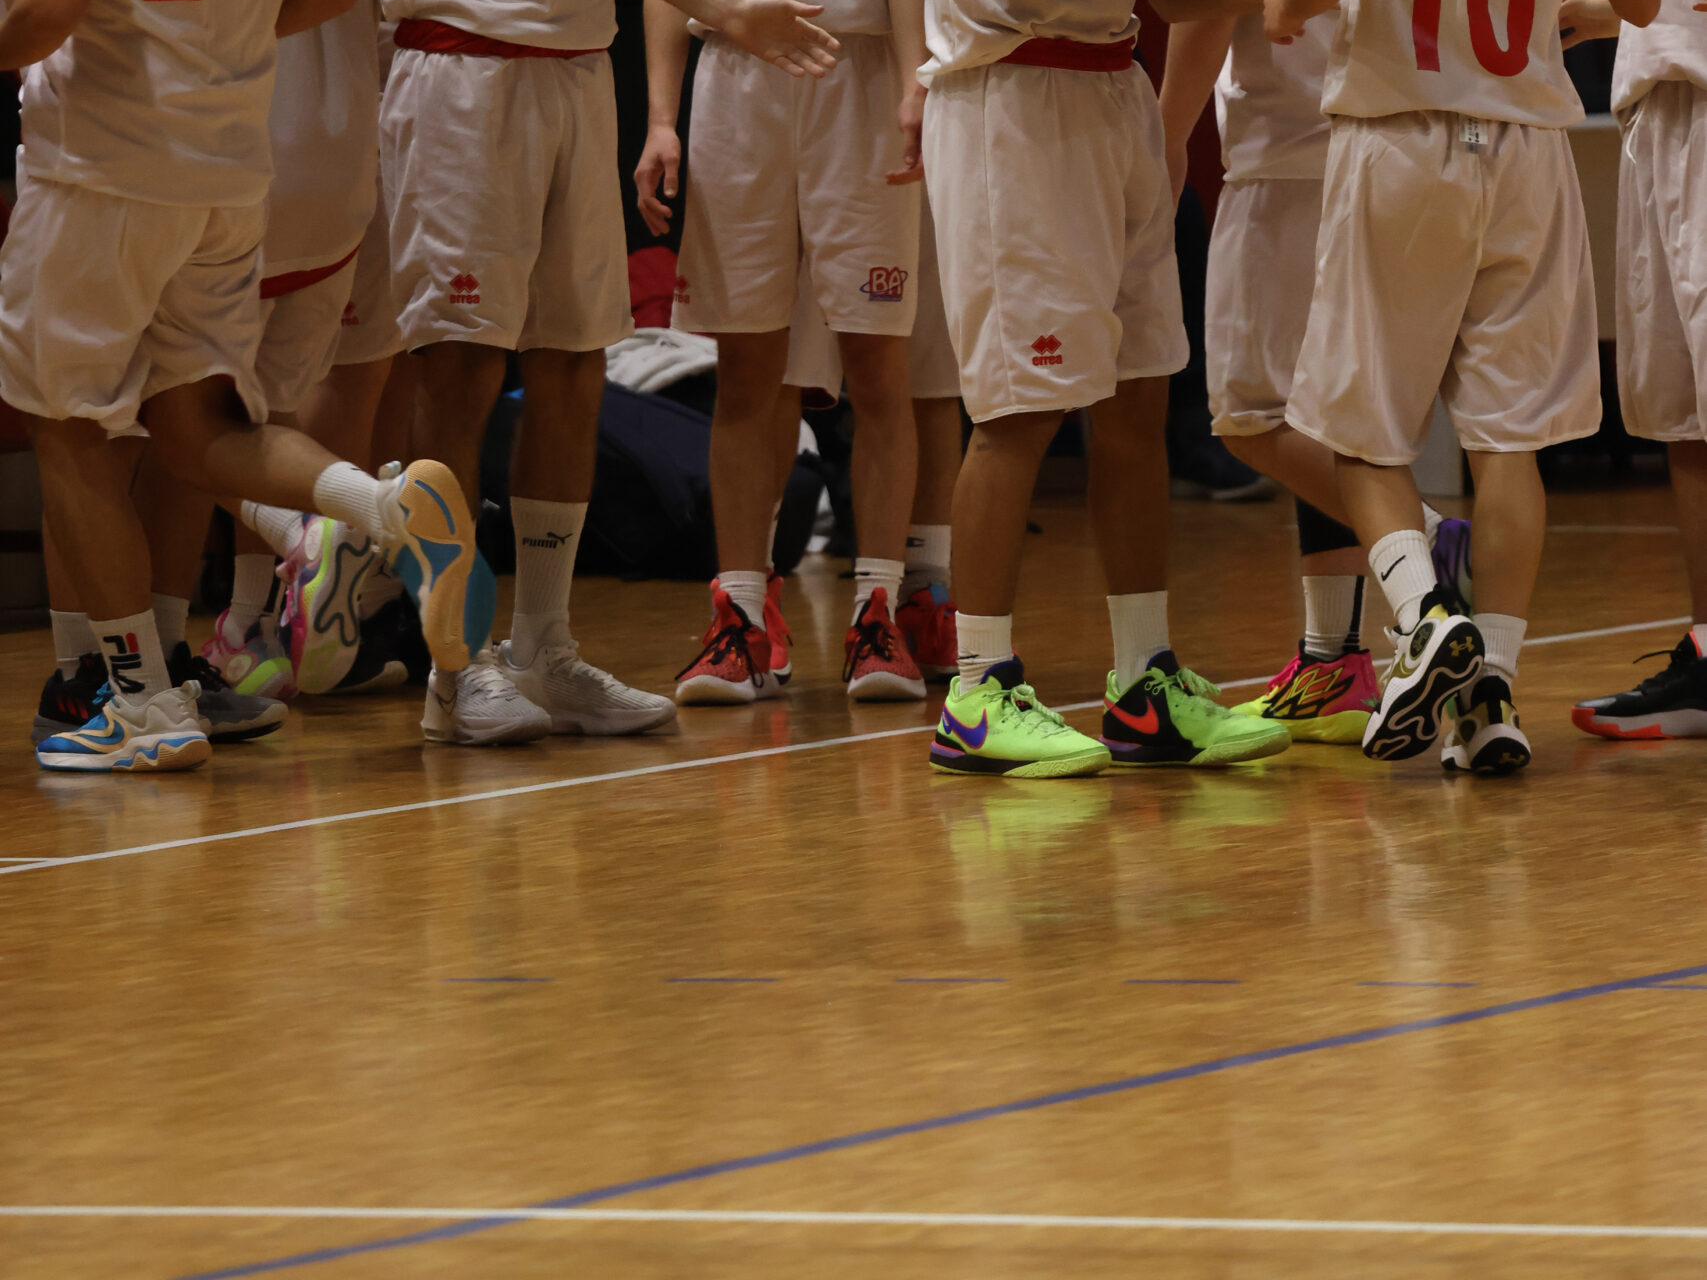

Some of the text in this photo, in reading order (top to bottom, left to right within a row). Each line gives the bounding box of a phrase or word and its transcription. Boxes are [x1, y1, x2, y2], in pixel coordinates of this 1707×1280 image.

[870, 267, 904, 296] BA
[1032, 354, 1063, 366] errea
[103, 632, 146, 694] FILA
